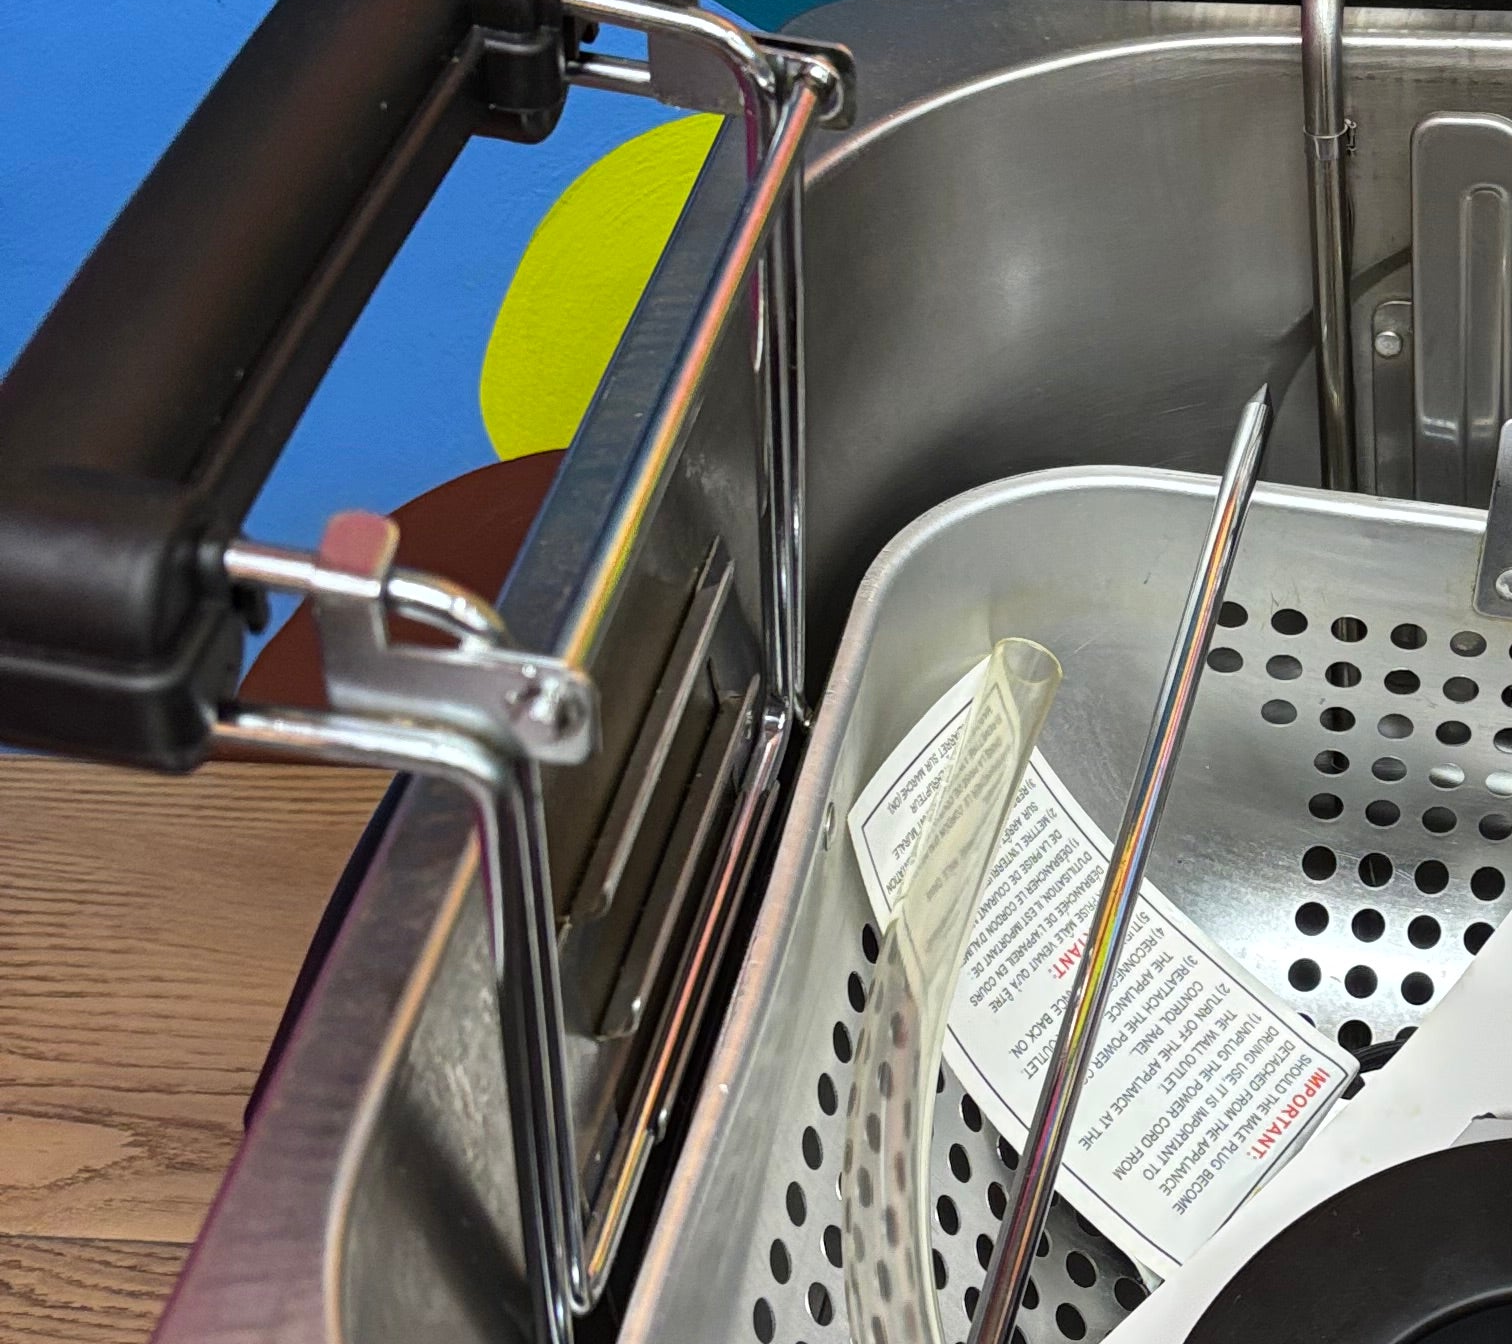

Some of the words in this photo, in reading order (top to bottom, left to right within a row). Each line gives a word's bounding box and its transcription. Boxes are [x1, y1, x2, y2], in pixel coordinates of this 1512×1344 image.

[1042, 912, 1057, 928] DE
[994, 963, 1008, 979] EN
[1149, 951, 1173, 973] THE
[968, 975, 996, 1006] COURS
[1141, 964, 1189, 1014] REATTACH
[1158, 980, 1203, 1024] CONTROL
[1122, 1011, 1147, 1034] THE
[1193, 993, 1222, 1021] TURN
[1213, 1009, 1237, 1031] THE
[1024, 1012, 1053, 1041] BACK
[1128, 1024, 1163, 1055] PANEL.
[1177, 1019, 1197, 1042] OFF
[1190, 1029, 1219, 1055] WALL
[1216, 1021, 1254, 1061] UNPLUG
[1008, 1039, 1027, 1058] ON.
[1090, 1030, 1128, 1069] POWER
[1157, 1039, 1181, 1062] THE
[1243, 1025, 1279, 1064] DRUING
[1157, 1053, 1196, 1094] OUTLET.
[1198, 1059, 1221, 1082] THE
[1221, 1062, 1247, 1085] USE,
[1248, 1039, 1295, 1091] DETACHED
[1273, 1054, 1311, 1094] SHOULD
[1109, 1057, 1160, 1115] APPLIANCE
[1165, 1078, 1202, 1118] POWER
[1204, 1093, 1218, 1108] IS
[1214, 1083, 1228, 1097] IT
[1098, 1110, 1113, 1129] AT
[1223, 1088, 1253, 1120] FROM
[1246, 1067, 1329, 1159] IMPORTANT:
[1255, 1093, 1279, 1115] THE
[1077, 1126, 1102, 1150] THE
[1140, 1116, 1169, 1148] CORD
[1156, 1105, 1208, 1165] IMPORTANT
[1205, 1118, 1228, 1141] THE
[1232, 1112, 1261, 1143] MALE
[1111, 1146, 1144, 1180] FROM
[1158, 1136, 1209, 1196] APPLIANCE
[1209, 1139, 1238, 1170] PLUG
[1142, 1163, 1161, 1180] TO
[1171, 1168, 1214, 1215] BECOME
